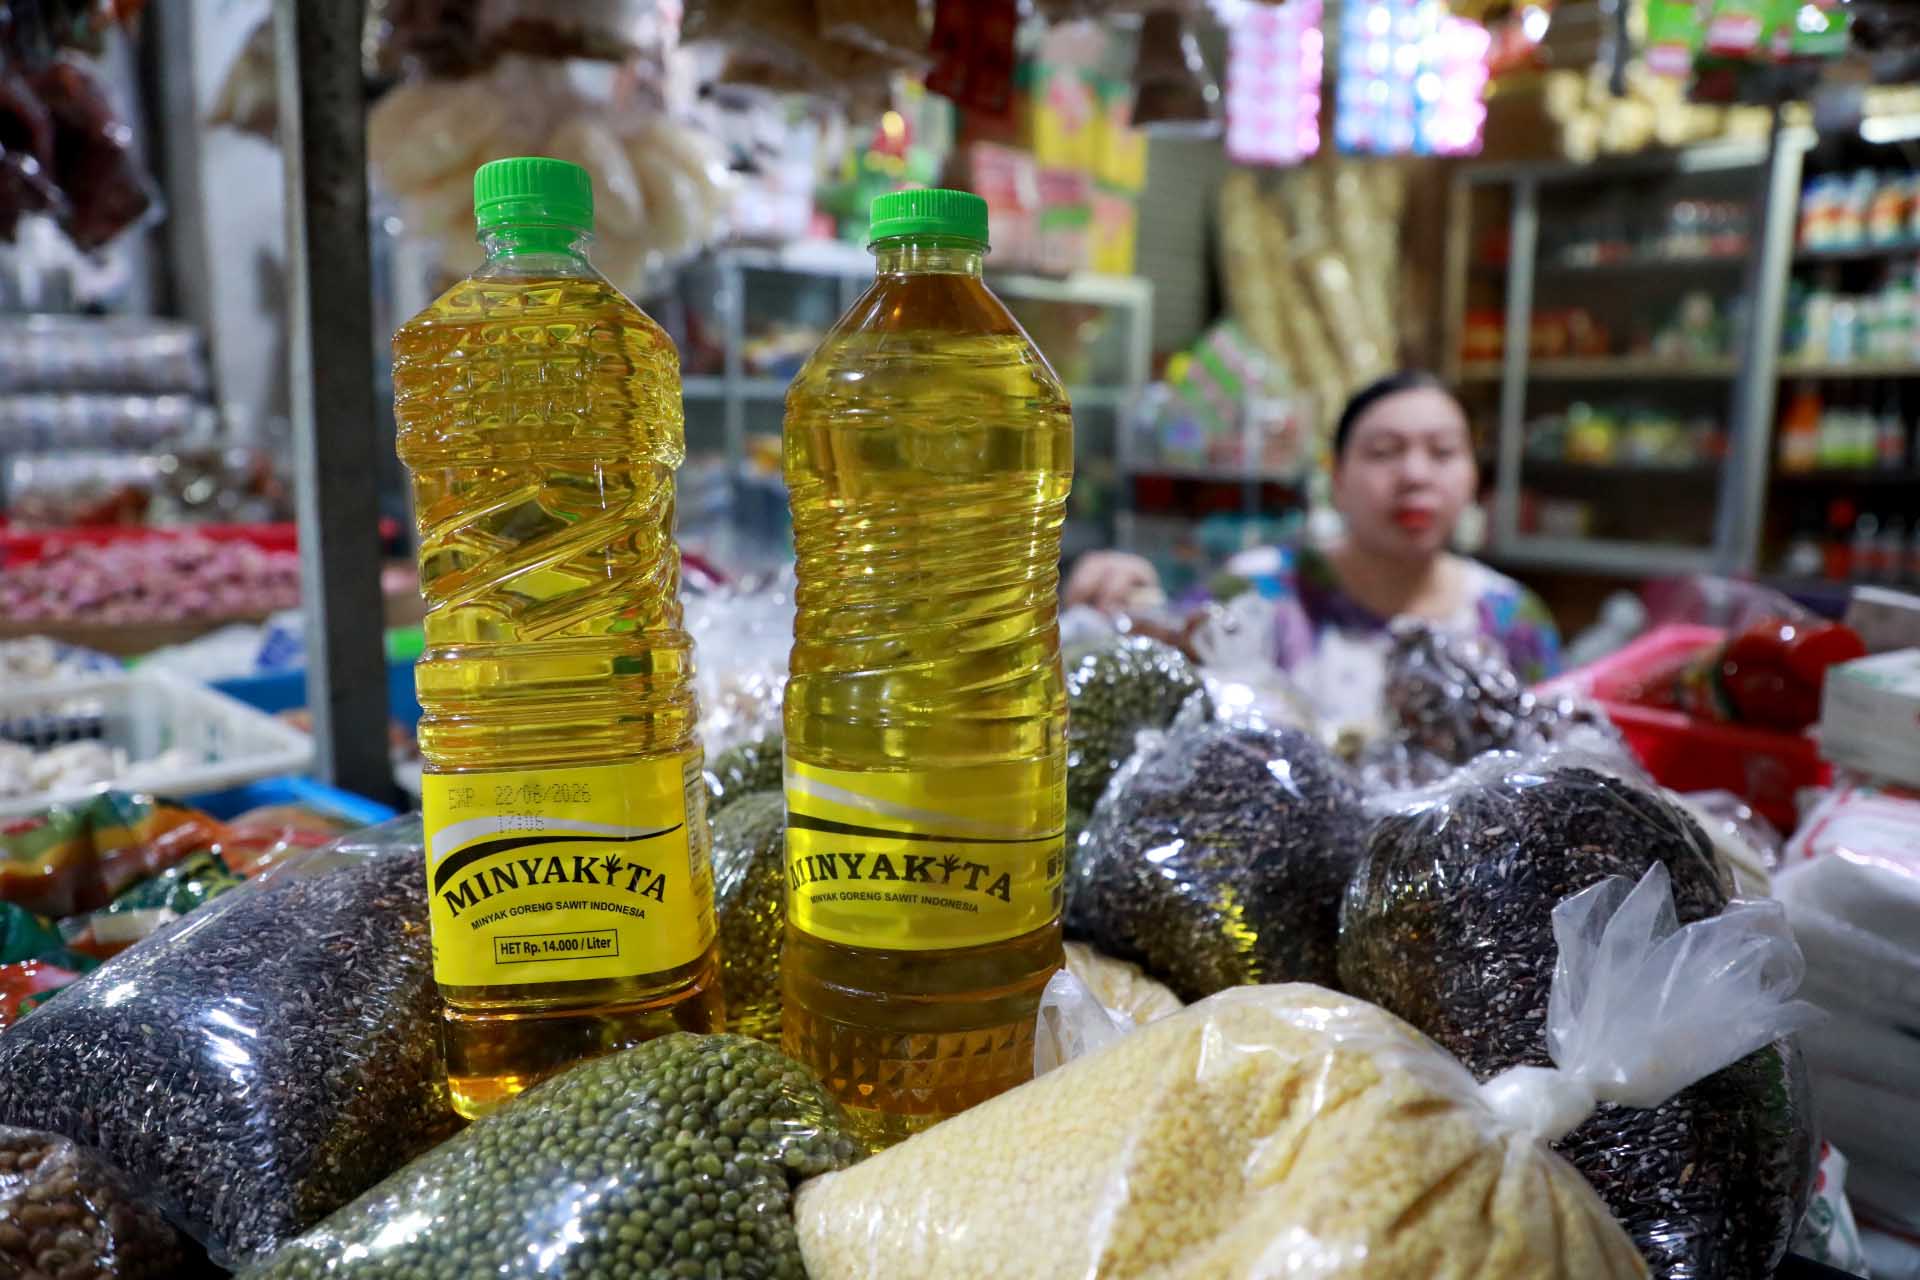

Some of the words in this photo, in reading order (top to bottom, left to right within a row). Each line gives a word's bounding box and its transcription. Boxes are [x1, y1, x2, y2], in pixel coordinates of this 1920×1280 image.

[810, 892, 839, 905] MINYAK
[840, 891, 882, 902] GORENG
[884, 892, 918, 904] SAWIT
[921, 895, 980, 914] INDONESIA
[471, 910, 508, 931] MINYAK
[510, 903, 553, 917] GORENG
[555, 901, 588, 911] SAWIT
[590, 901, 646, 919] INDONESIA
[501, 942, 521, 955] HET
[523, 941, 541, 956] Rp.
[543, 939, 579, 953] 14.000
[587, 936, 612, 950] Liter
